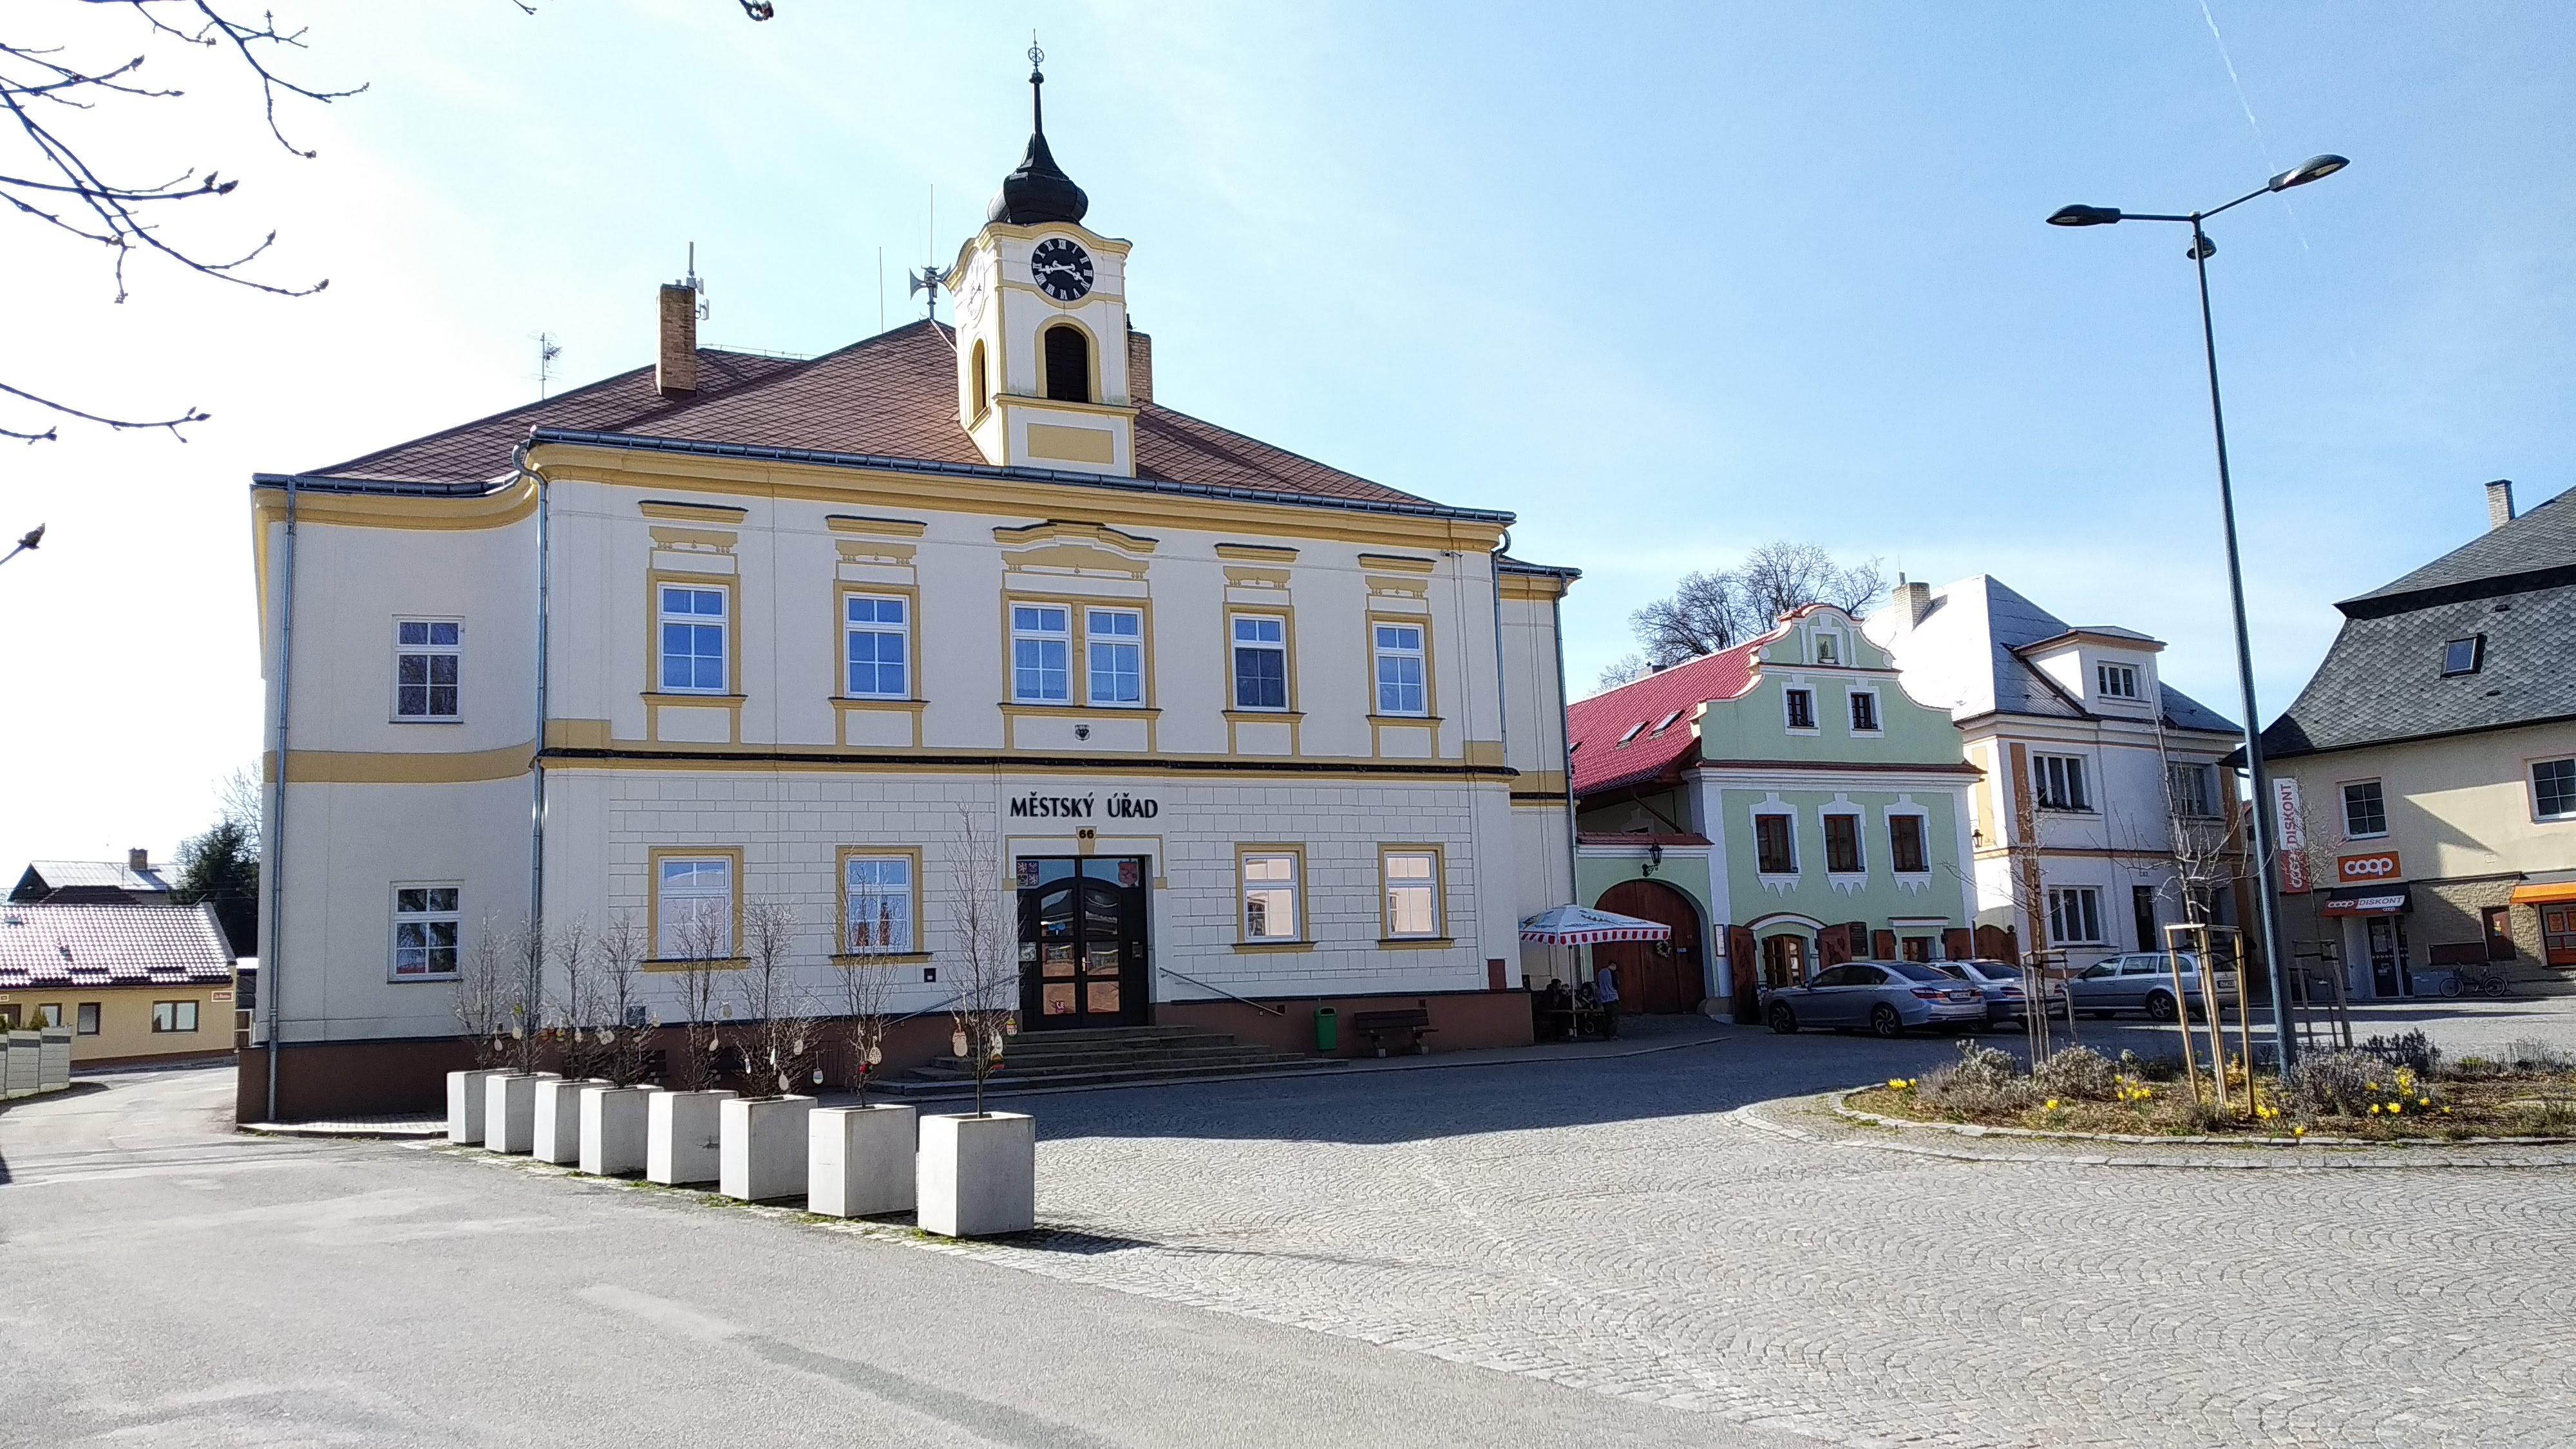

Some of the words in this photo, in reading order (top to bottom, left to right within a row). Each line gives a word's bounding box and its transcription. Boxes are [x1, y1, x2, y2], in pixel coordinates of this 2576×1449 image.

[1057, 240, 1066, 250] XII
[1072, 245, 1078, 254] I
[1036, 249, 1046, 259] X
[1060, 289, 1068, 300] VI
[1073, 287, 1081, 298] V
[1010, 791, 1095, 817] MĚSTSKÝ
[1107, 792, 1159, 818] ÚŘAD
[2280, 783, 2297, 845] DISKONT
[1078, 829, 1095, 839] 66
[2344, 857, 2393, 876] coop
[2327, 900, 2354, 909] coop
[2359, 896, 2403, 906] DISKONT
